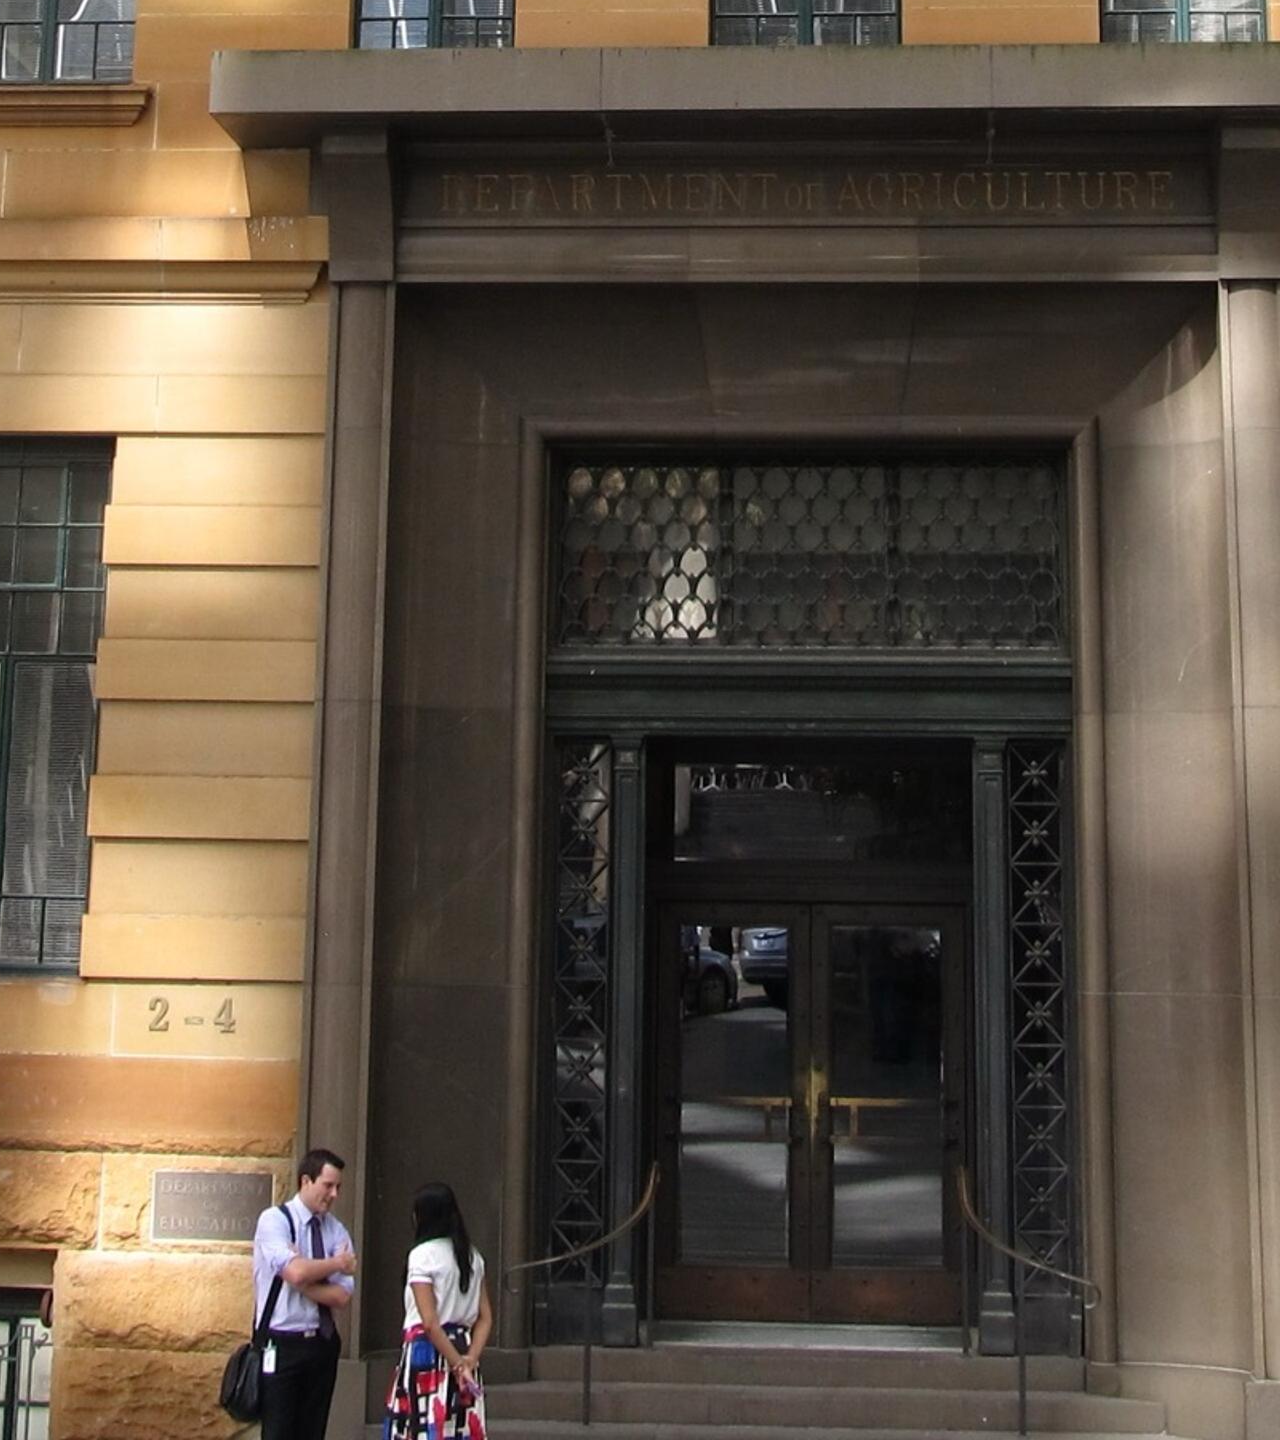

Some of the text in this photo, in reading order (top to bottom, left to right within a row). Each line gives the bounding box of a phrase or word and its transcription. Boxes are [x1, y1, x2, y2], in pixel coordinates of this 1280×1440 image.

[439, 172, 779, 212] DEPARTMENT
[836, 171, 1175, 211] AGRICULTURE
[159, 1215, 255, 1233] EDUCATIO
